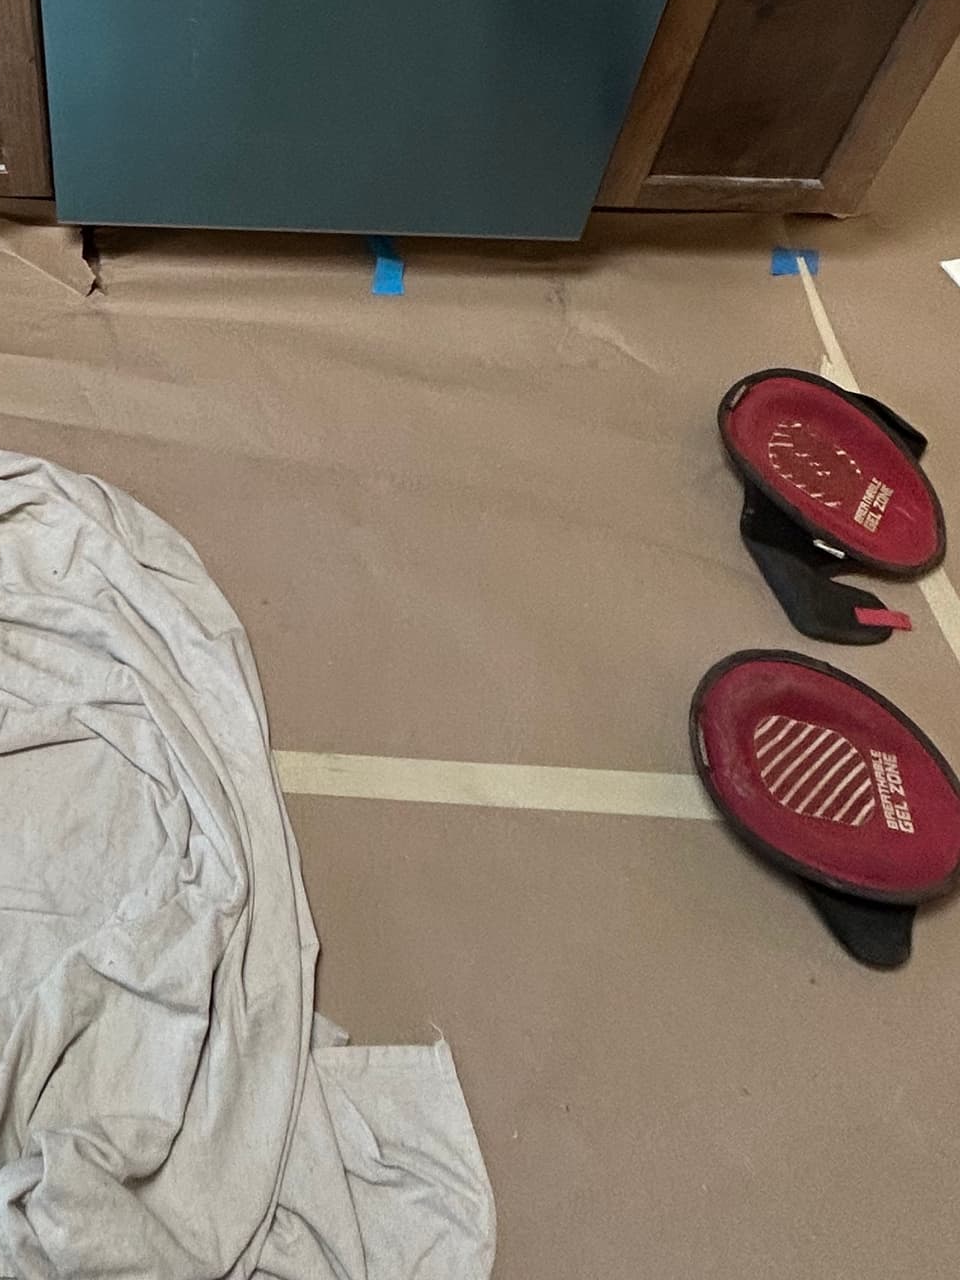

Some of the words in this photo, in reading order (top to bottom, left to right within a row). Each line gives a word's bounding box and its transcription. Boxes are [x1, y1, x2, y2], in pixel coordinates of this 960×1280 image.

[864, 511, 882, 533] GEL
[873, 483, 894, 512] ZONE
[870, 749, 899, 830] BREATHABLE
[883, 752, 905, 796] ZONE
[895, 801, 915, 834] GEL
